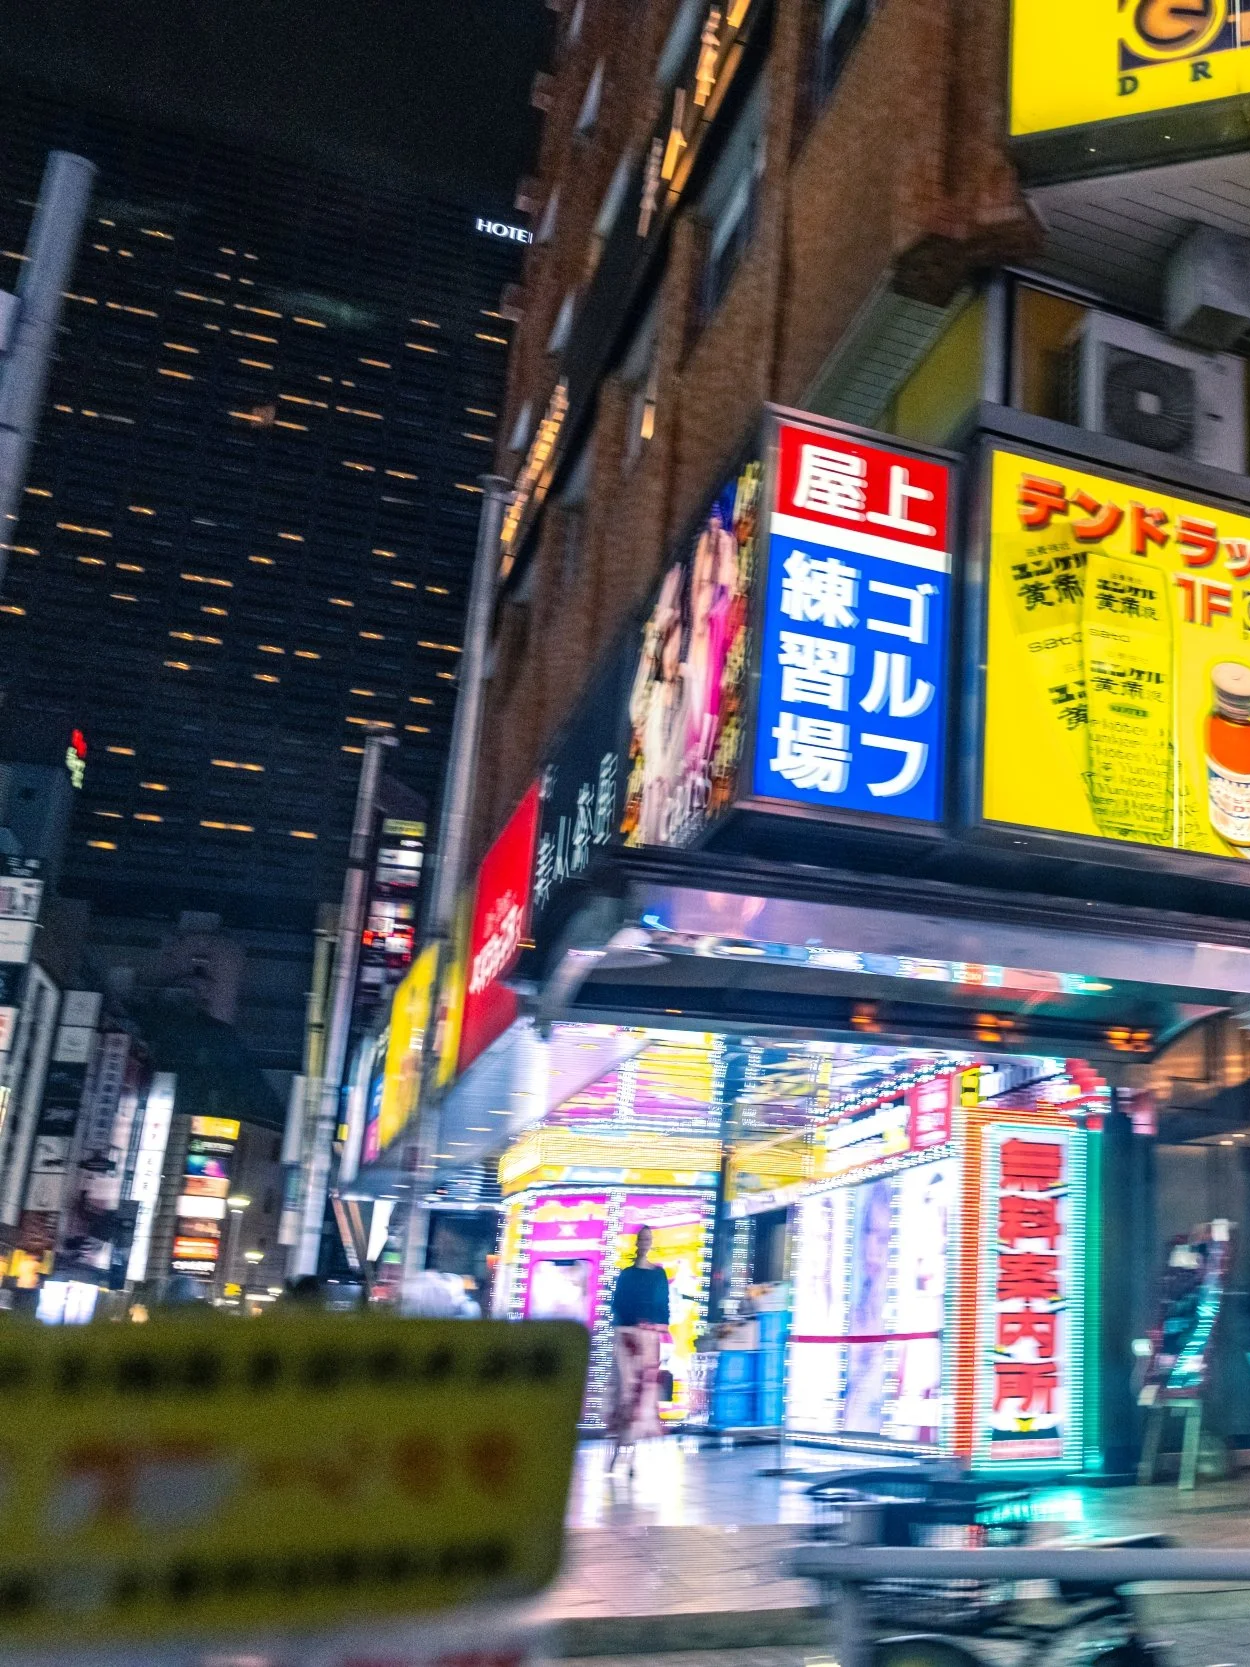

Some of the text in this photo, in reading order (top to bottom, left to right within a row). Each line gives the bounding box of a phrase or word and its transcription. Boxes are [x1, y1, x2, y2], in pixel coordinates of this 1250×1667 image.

[792, 443, 938, 538] 屋上
[769, 550, 861, 794] 練習場
[1172, 570, 1234, 628] 1F
[859, 579, 940, 798] ゴルフ
